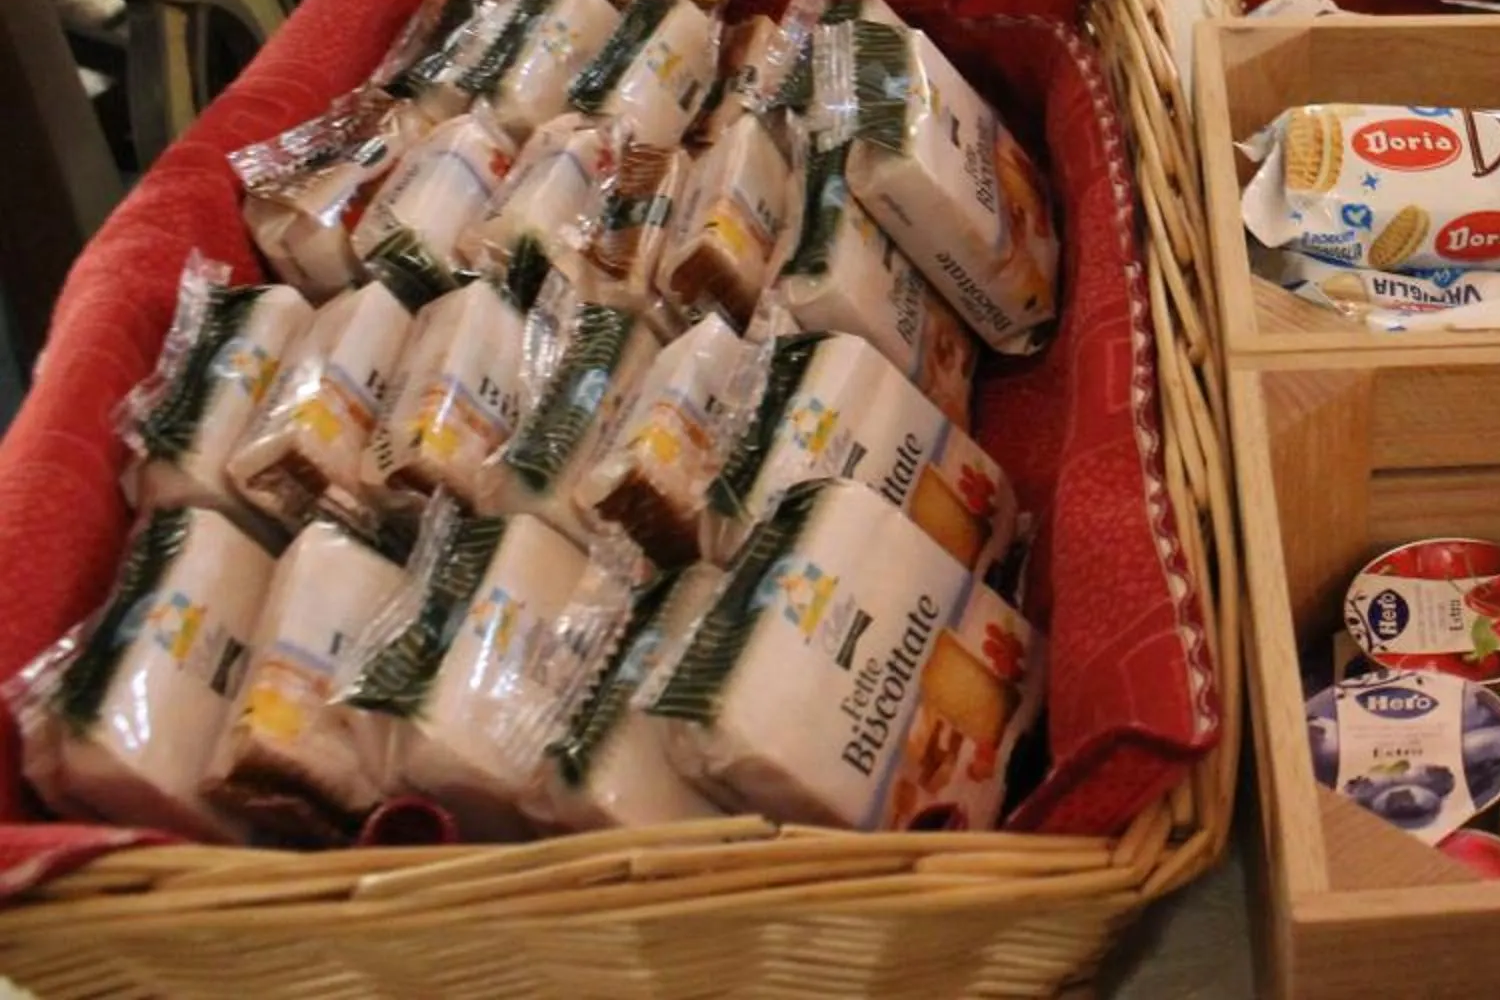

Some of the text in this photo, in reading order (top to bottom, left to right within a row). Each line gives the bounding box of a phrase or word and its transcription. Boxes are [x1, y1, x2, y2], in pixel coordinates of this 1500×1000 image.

[1362, 130, 1453, 154] Doria
[1376, 592, 1399, 636] Hero
[841, 657, 884, 721] Fette
[842, 594, 939, 778] Biscottate
[1367, 693, 1434, 711] Hero
